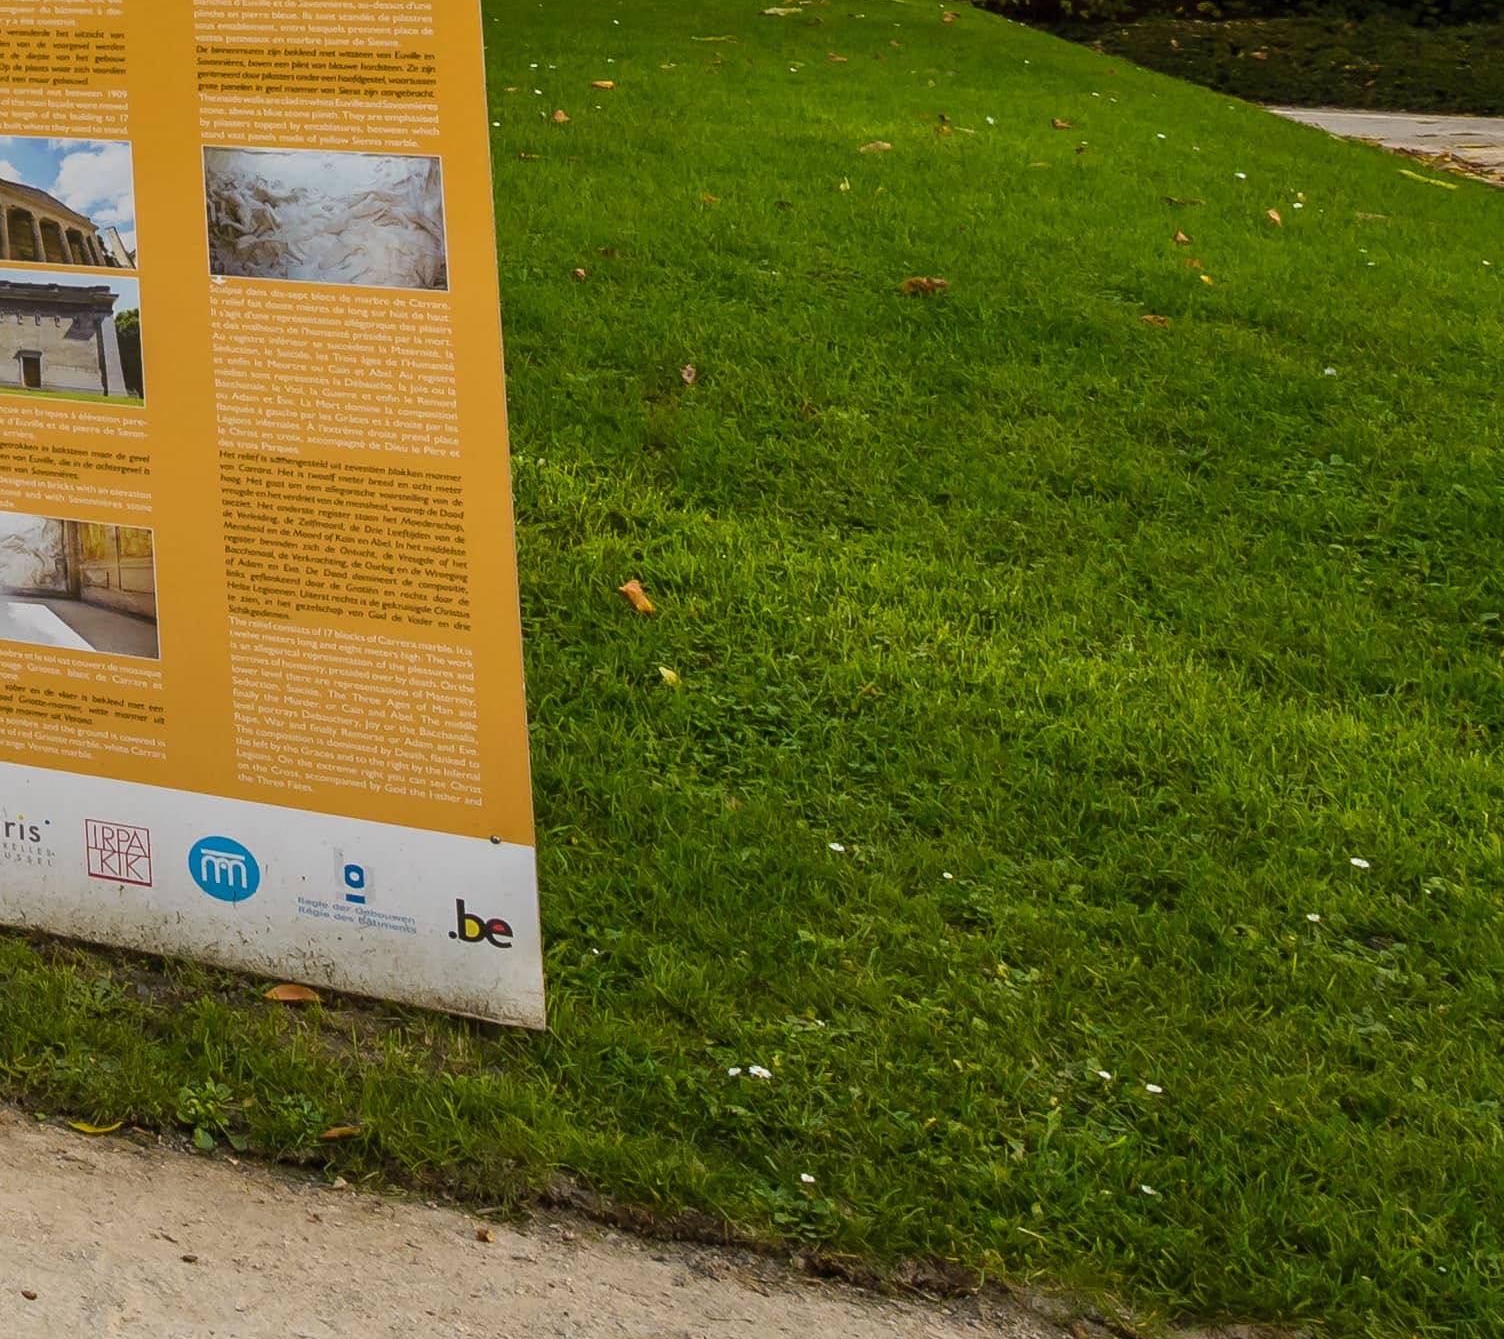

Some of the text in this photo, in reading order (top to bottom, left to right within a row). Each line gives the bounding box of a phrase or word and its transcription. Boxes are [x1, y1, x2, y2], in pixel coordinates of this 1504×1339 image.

[234, 723, 480, 769] The composition is dominated by Death, flanked to
[447, 897, 514, 949] .be
